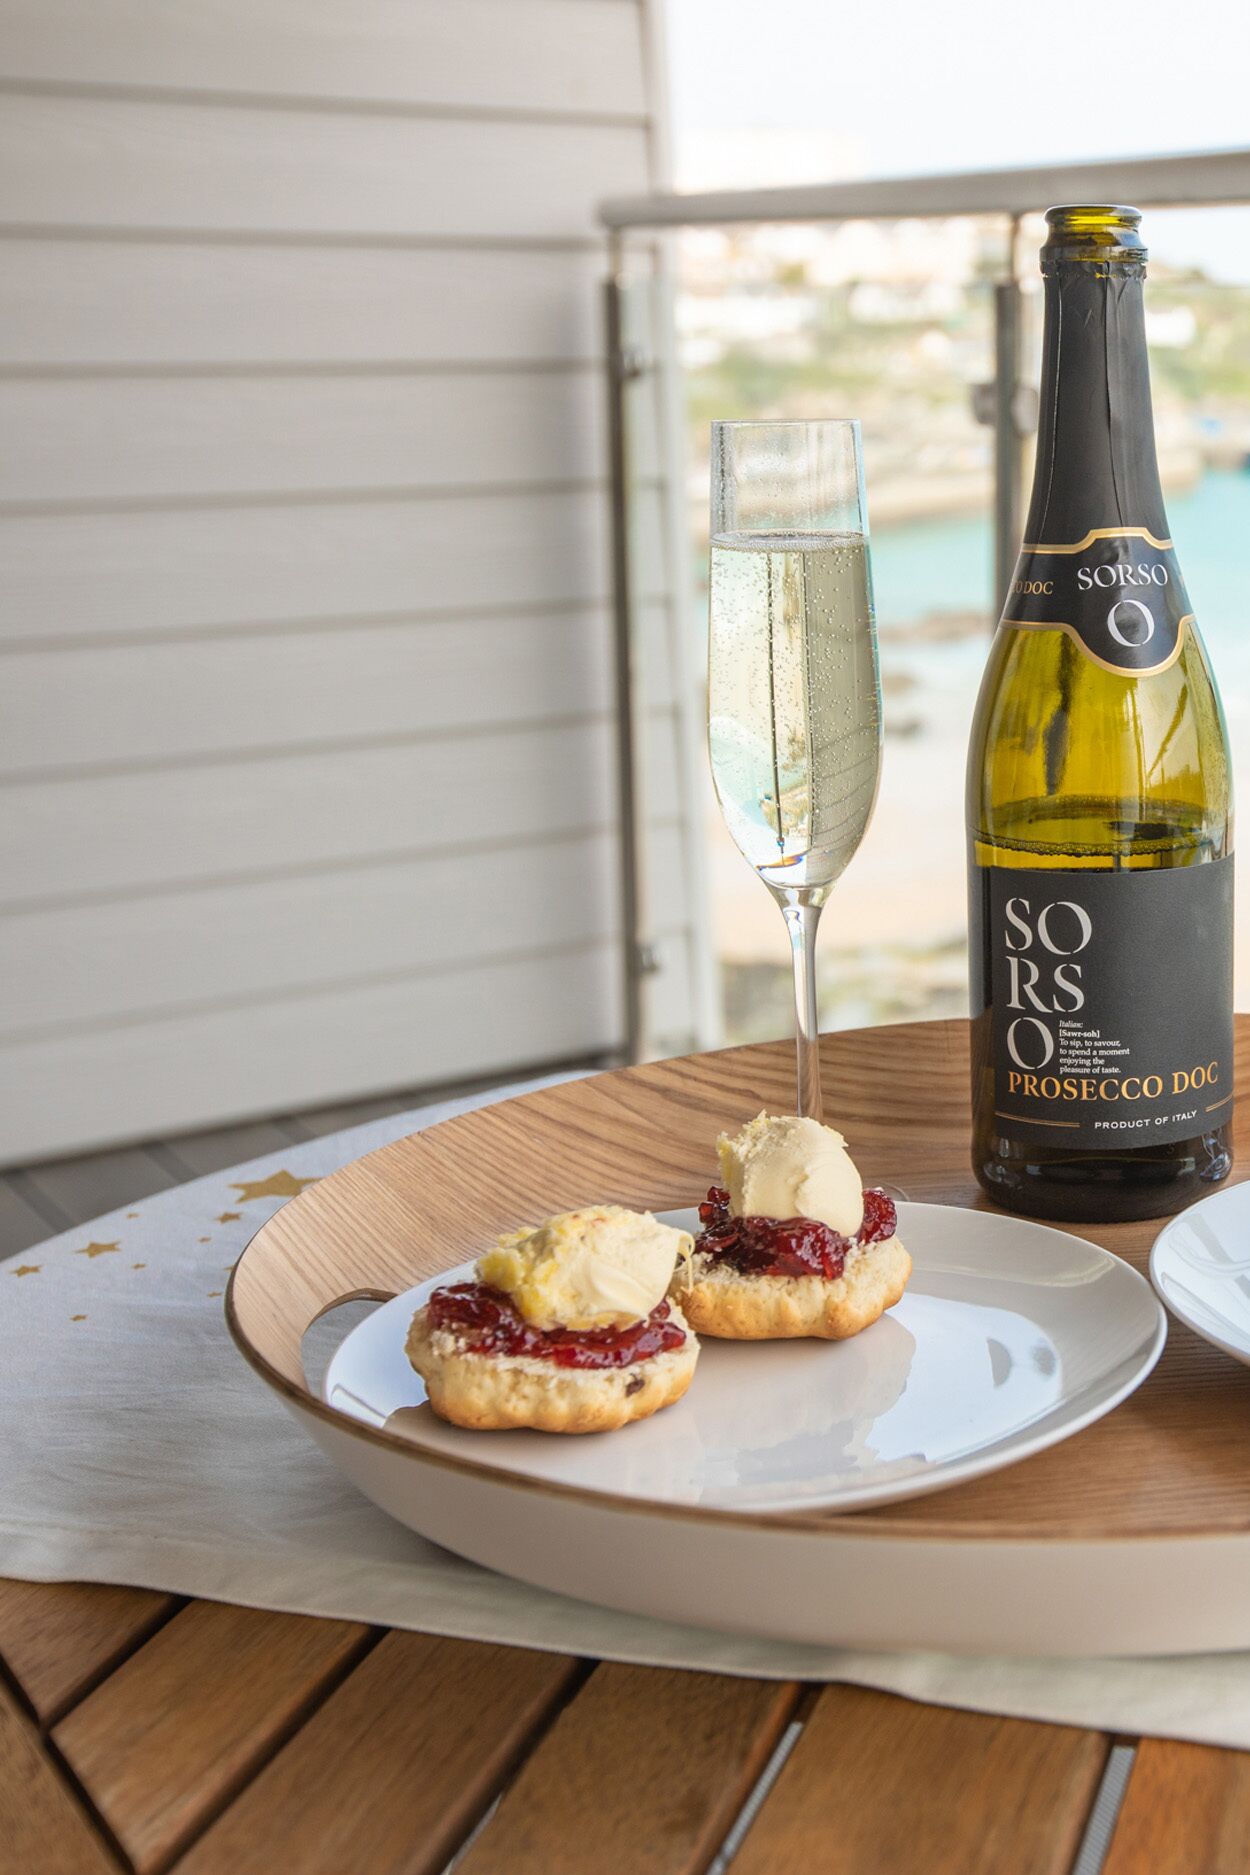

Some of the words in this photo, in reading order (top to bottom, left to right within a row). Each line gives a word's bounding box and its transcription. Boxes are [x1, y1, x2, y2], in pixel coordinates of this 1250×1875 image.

[1077, 564, 1168, 590] SORSO
[1023, 581, 1053, 595] DOC
[1005, 898, 1092, 955] SO
[1005, 956, 1085, 1013] RS
[1007, 1017, 1054, 1070] O
[1059, 1038, 1069, 1046] To
[1059, 1057, 1091, 1067] enjoying
[1092, 1057, 1105, 1065] the
[1069, 1048, 1091, 1057] spend
[1098, 1048, 1130, 1056] moment
[1059, 1066, 1091, 1074] pleasure
[1092, 1066, 1100, 1074] of
[1101, 1066, 1121, 1074] taste.
[1008, 1070, 1163, 1101] PROSECCO
[1172, 1061, 1218, 1095] DOC
[1094, 1118, 1151, 1129] PRODUCT
[1155, 1116, 1169, 1125] OF
[1172, 1110, 1198, 1122] ITALY
